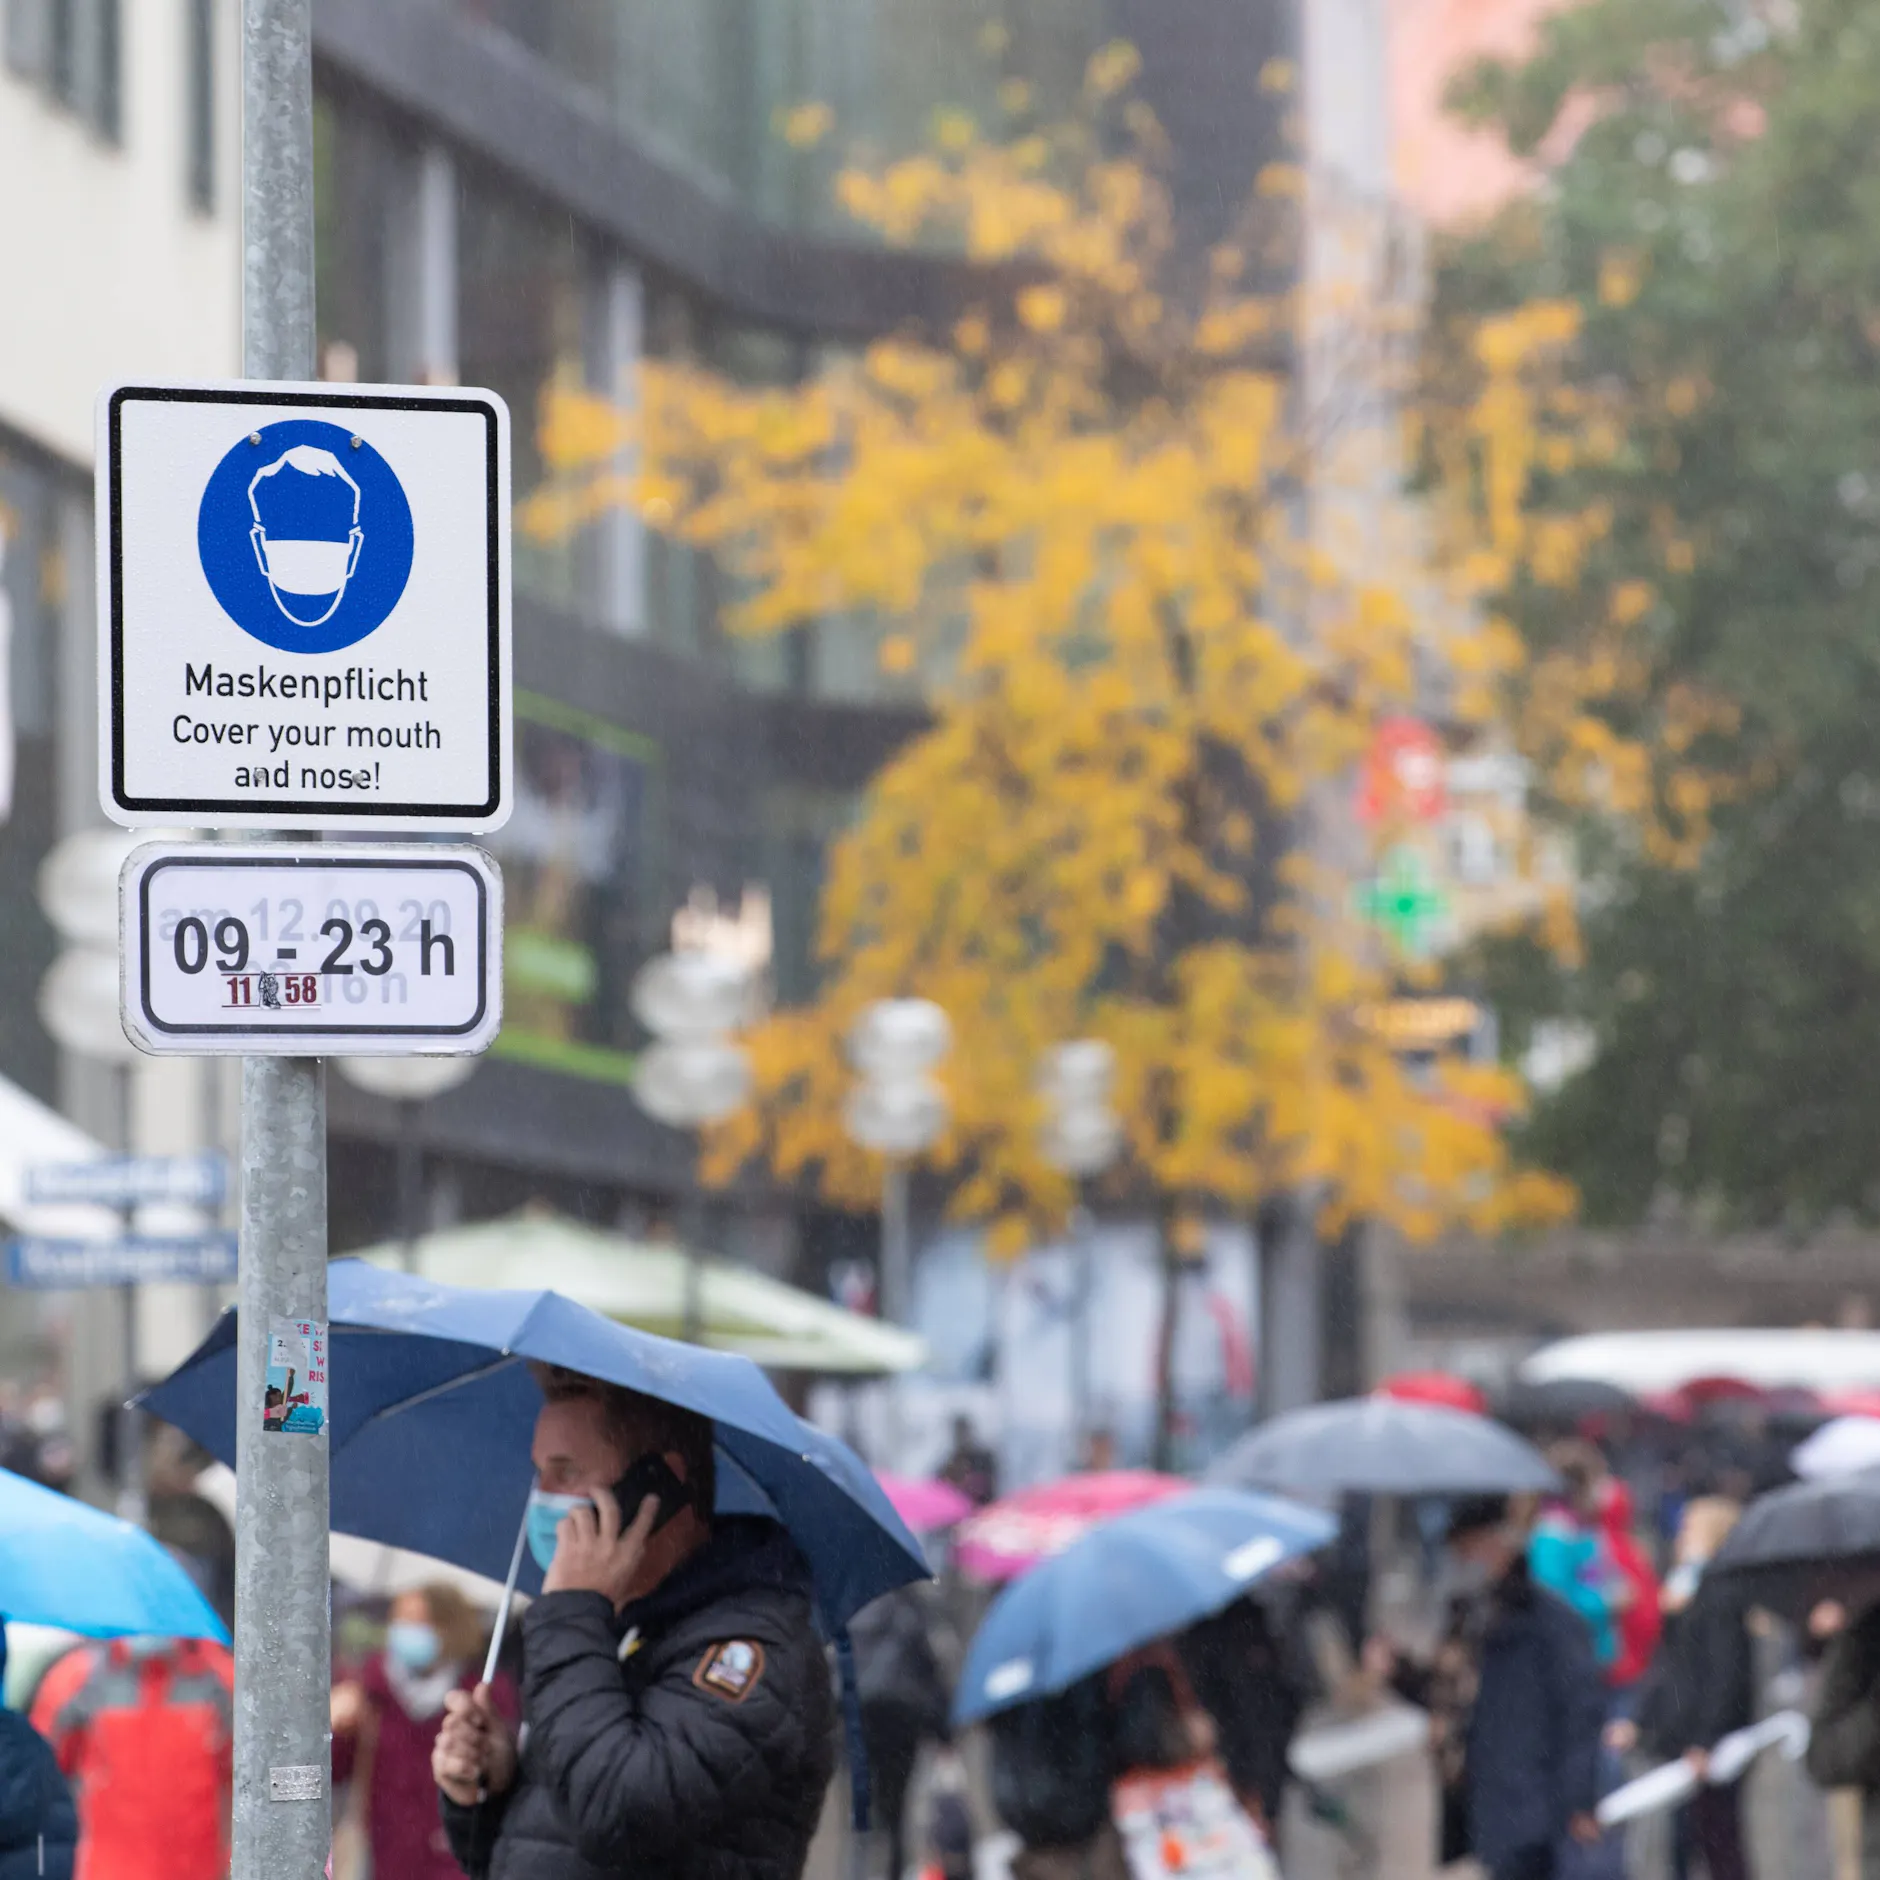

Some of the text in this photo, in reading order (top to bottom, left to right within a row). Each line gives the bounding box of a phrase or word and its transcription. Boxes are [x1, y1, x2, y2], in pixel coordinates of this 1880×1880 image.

[185, 662, 428, 709] Maskenpflicht
[173, 714, 441, 753] Cover your mouth
[234, 759, 380, 790] and nose!
[173, 916, 250, 975] 09
[319, 918, 393, 976] 23
[420, 919, 455, 976] h
[226, 976, 317, 1005] 11 58
